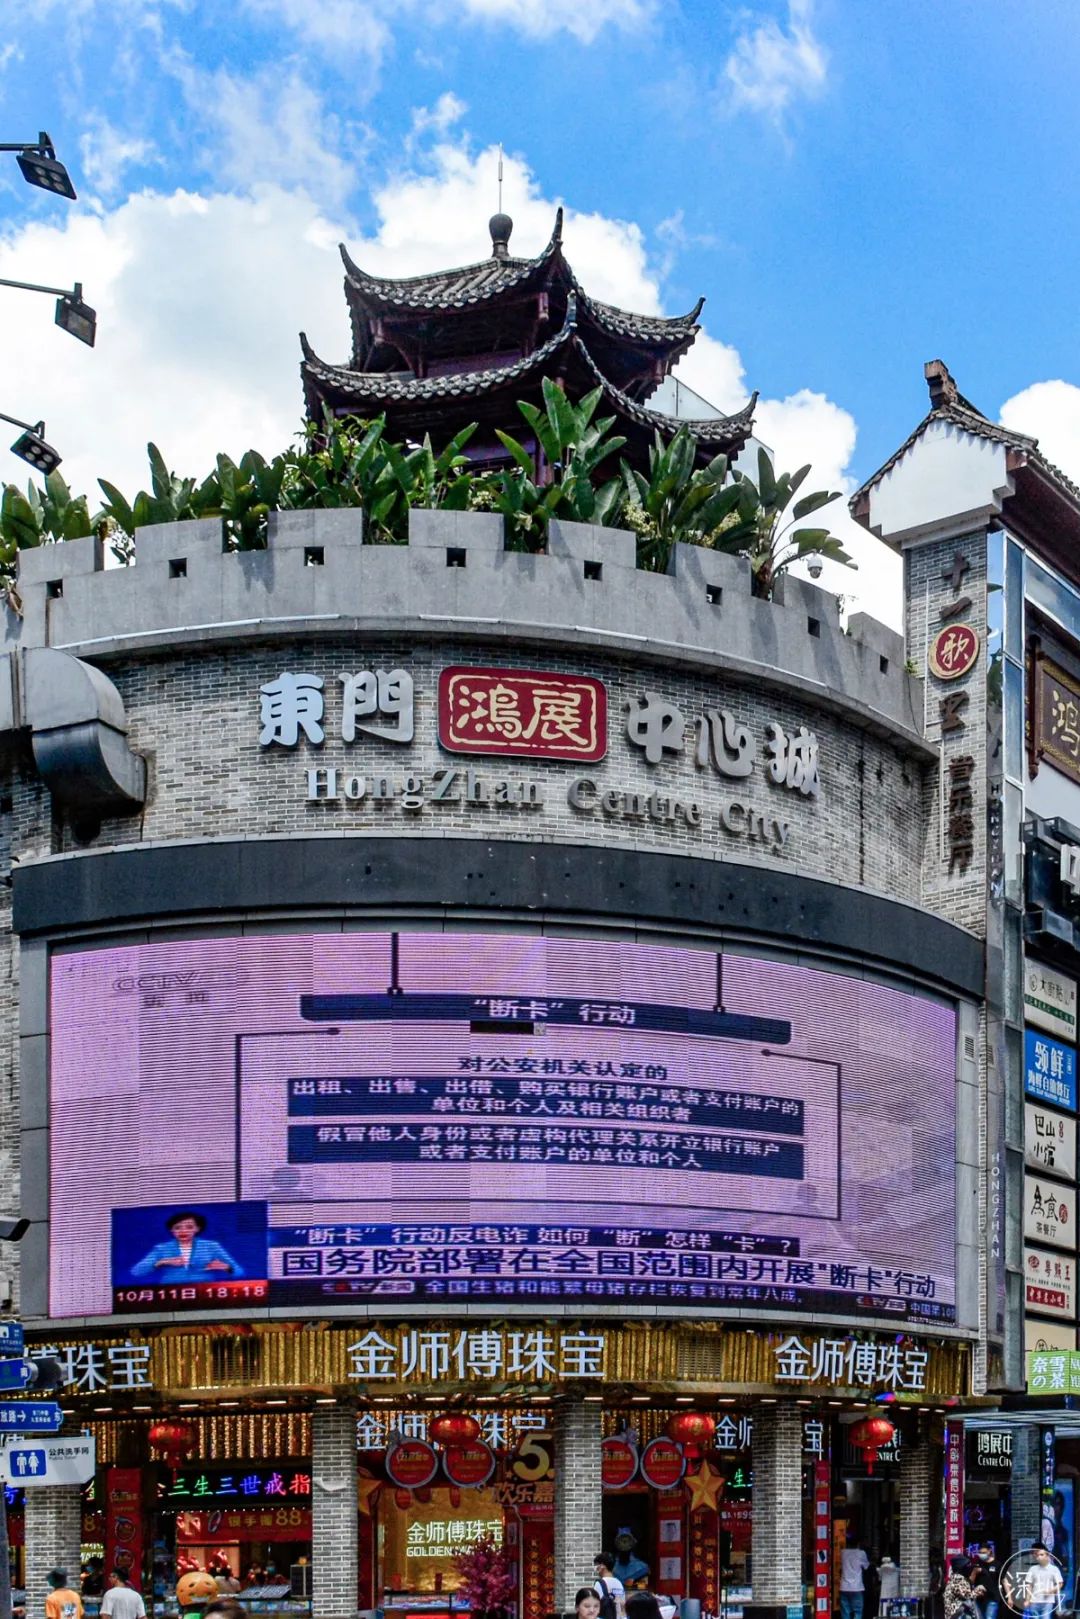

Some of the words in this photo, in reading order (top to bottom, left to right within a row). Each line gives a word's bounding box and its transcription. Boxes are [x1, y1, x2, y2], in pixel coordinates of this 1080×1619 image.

[259, 668, 415, 747] 東門
[305, 767, 544, 811] HongZhan
[567, 778, 702, 825] Centre
[719, 801, 791, 850] City
[458, 1056, 668, 1080] 对公安机关认定的
[432, 1096, 692, 1122] 单位和个人及相关组织者
[1034, 1113, 1056, 1138] 巴山
[419, 1144, 703, 1168] 或者支付账户的单位和个人
[990, 1151, 1001, 1258] HONGZHAN
[116, 1286, 198, 1302] 10月11日
[206, 1285, 266, 1299] 18:18
[347, 1329, 605, 1379] 金师傅珠宝
[775, 1335, 929, 1391] 金师傅珠宝
[167, 1472, 312, 1497] 三生三世戒指
